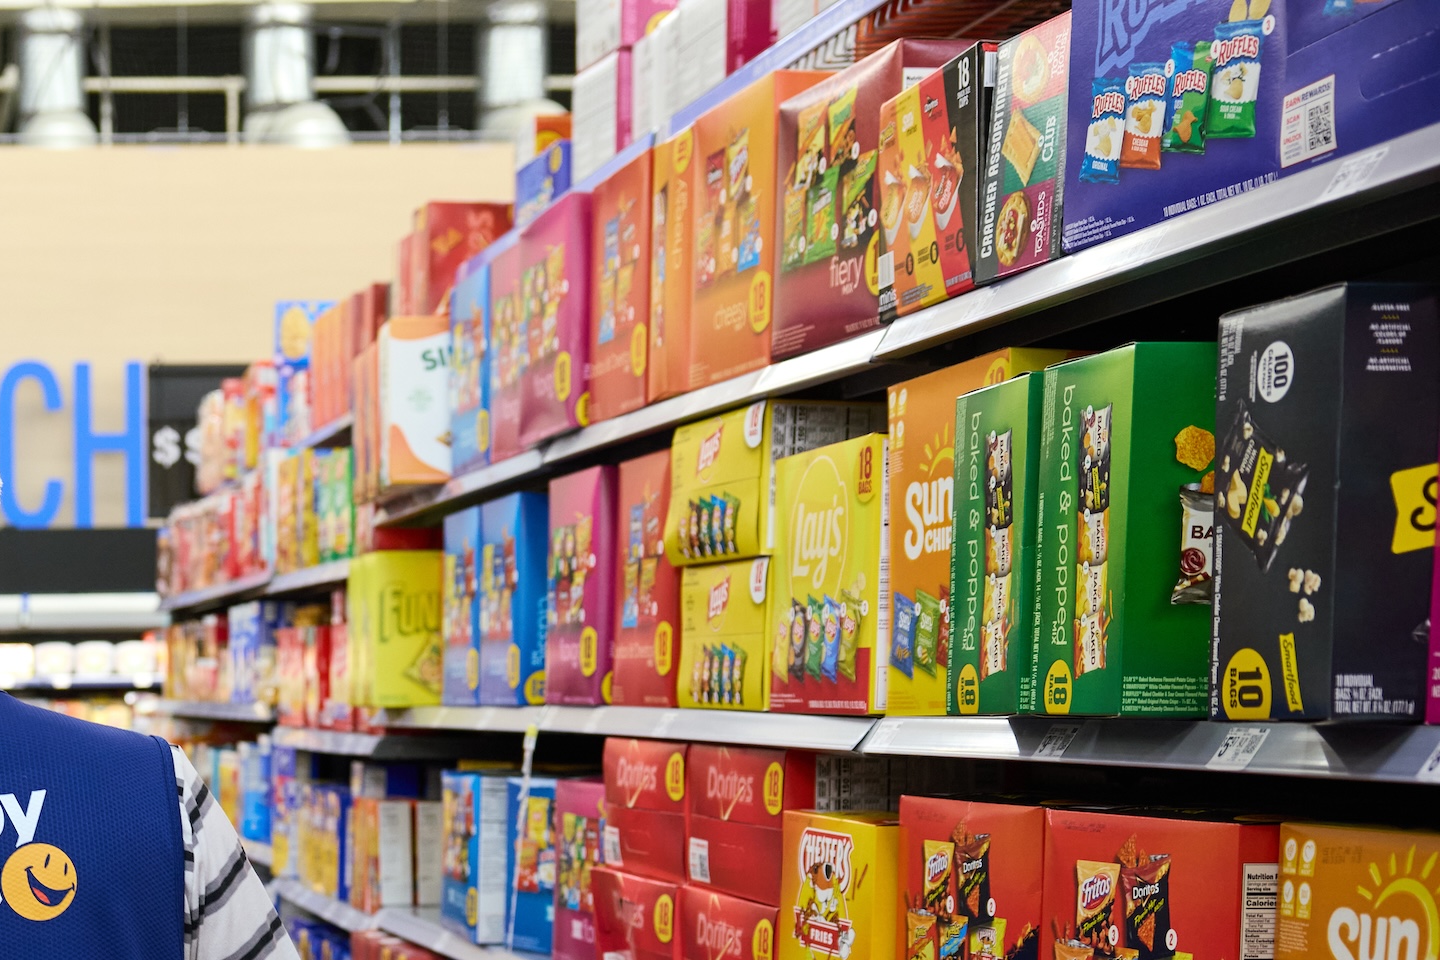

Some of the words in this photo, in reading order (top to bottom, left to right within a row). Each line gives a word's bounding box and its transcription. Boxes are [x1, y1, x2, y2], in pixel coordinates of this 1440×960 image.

[1215, 35, 1259, 66] RUFFLES
[958, 56, 970, 91] 18
[1130, 72, 1165, 100] RUFFLES
[1172, 70, 1206, 97] RUFFLES
[988, 64, 1010, 177] ASSORTMENT
[1093, 92, 1124, 118] RUFFLES
[1041, 115, 1057, 163] CLUB
[1092, 160, 1108, 172] ORIGINAL
[980, 180, 998, 259] CRACKER
[830, 252, 864, 289] fiery
[1273, 351, 1288, 389] 100
[1060, 385, 1076, 481] baked
[859, 446, 872, 486] 18
[969, 411, 982, 501] baked
[858, 482, 872, 495] BAGS
[1060, 491, 1072, 515] &
[1247, 455, 1267, 531] Smartfood
[968, 509, 980, 532] &
[792, 494, 844, 589] Lay's
[967, 540, 979, 651] popped
[1056, 524, 1070, 645] popped
[1053, 673, 1068, 705] 18
[1238, 666, 1264, 708] 10
[1282, 638, 1299, 706] Smartfood
[964, 676, 976, 706] 18
[617, 756, 657, 791] Doritos
[707, 765, 754, 803] Doritos
[768, 770, 779, 798] 18
[963, 858, 982, 874] Doritos
[1247, 872, 1274, 881] Nutrition
[1081, 874, 1111, 909] Fritos
[1132, 882, 1160, 900] Doritos
[697, 913, 743, 956] Doritos
[758, 924, 768, 955] 18
[810, 927, 834, 946] FRIES
